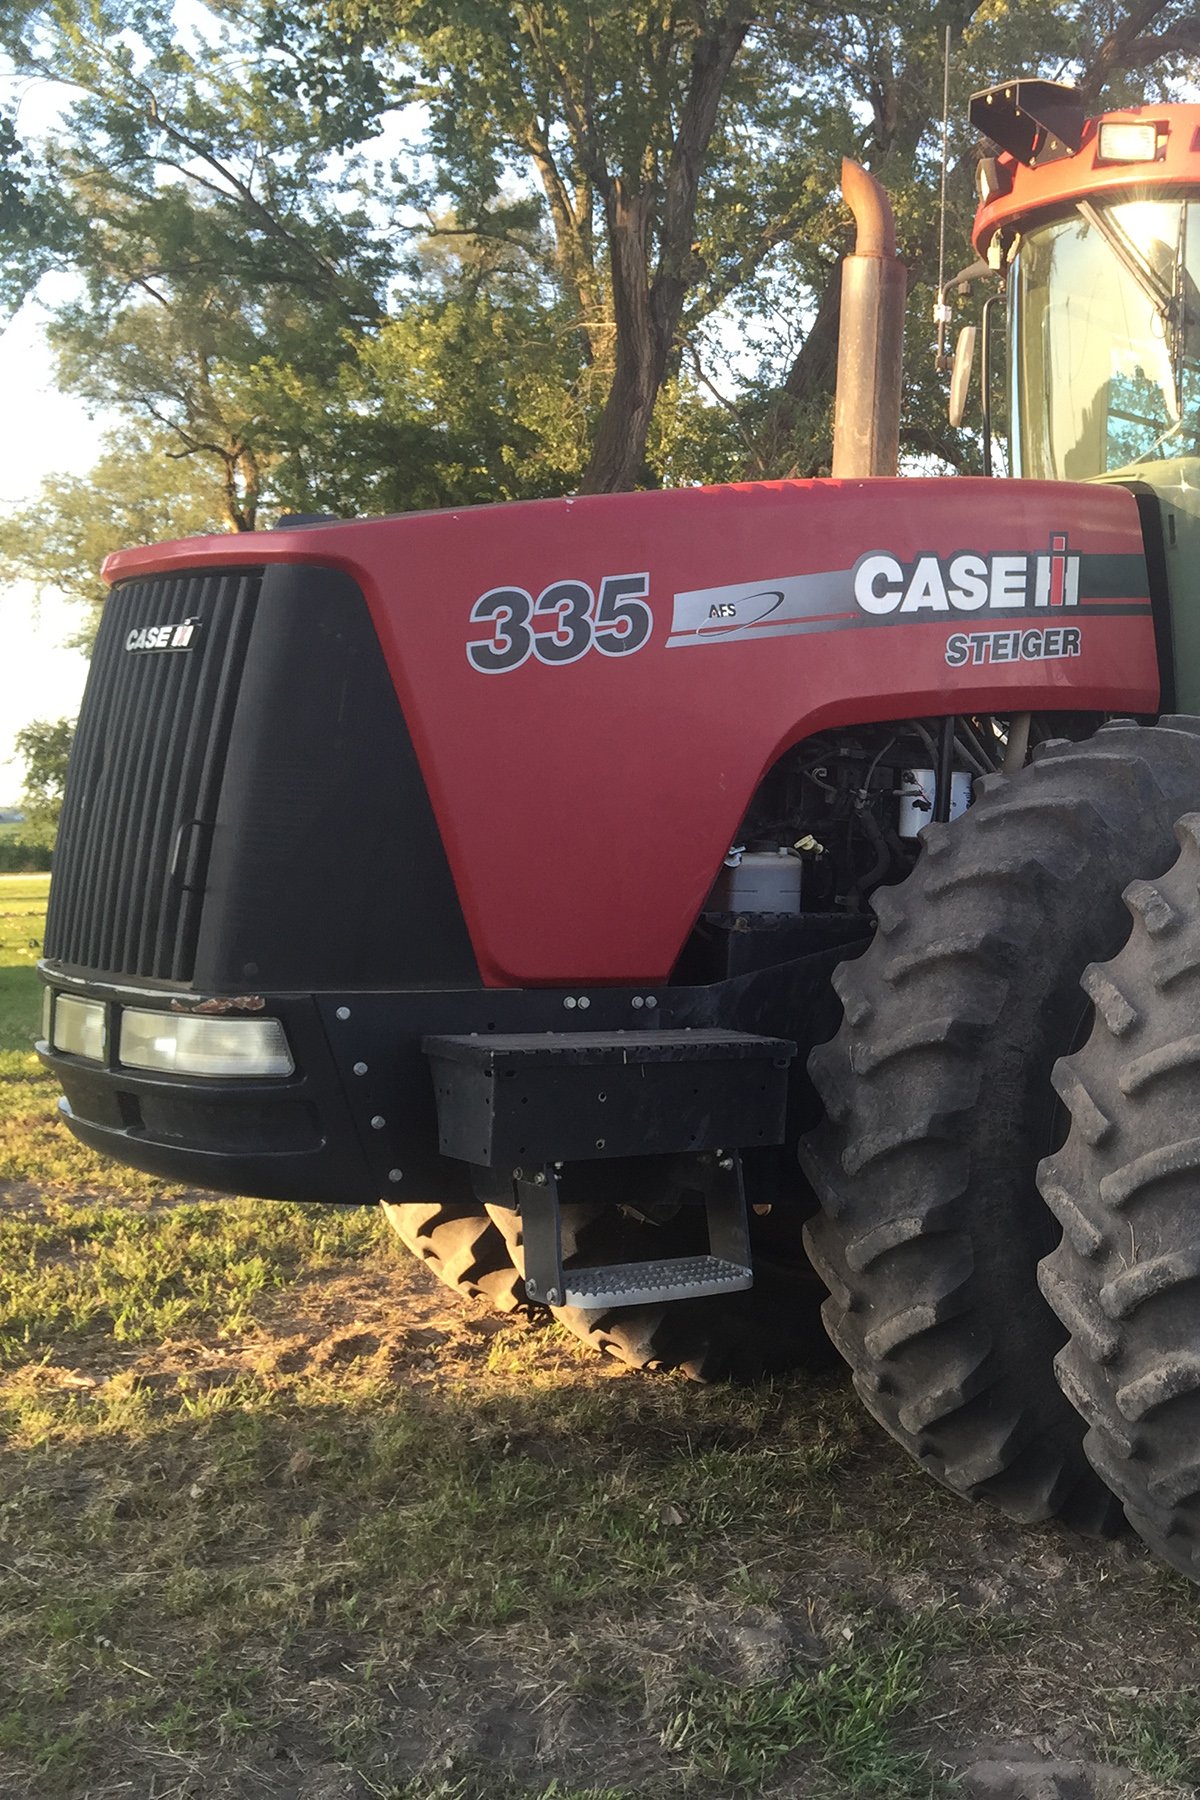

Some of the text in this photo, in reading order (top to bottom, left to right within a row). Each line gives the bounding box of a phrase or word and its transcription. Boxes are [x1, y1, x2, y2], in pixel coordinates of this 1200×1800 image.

[854, 555, 1027, 614] CASE
[466, 572, 653, 674] 335
[709, 603, 737, 618] AFS
[126, 627, 173, 651] CASE
[945, 627, 1081, 667] STEIGER
